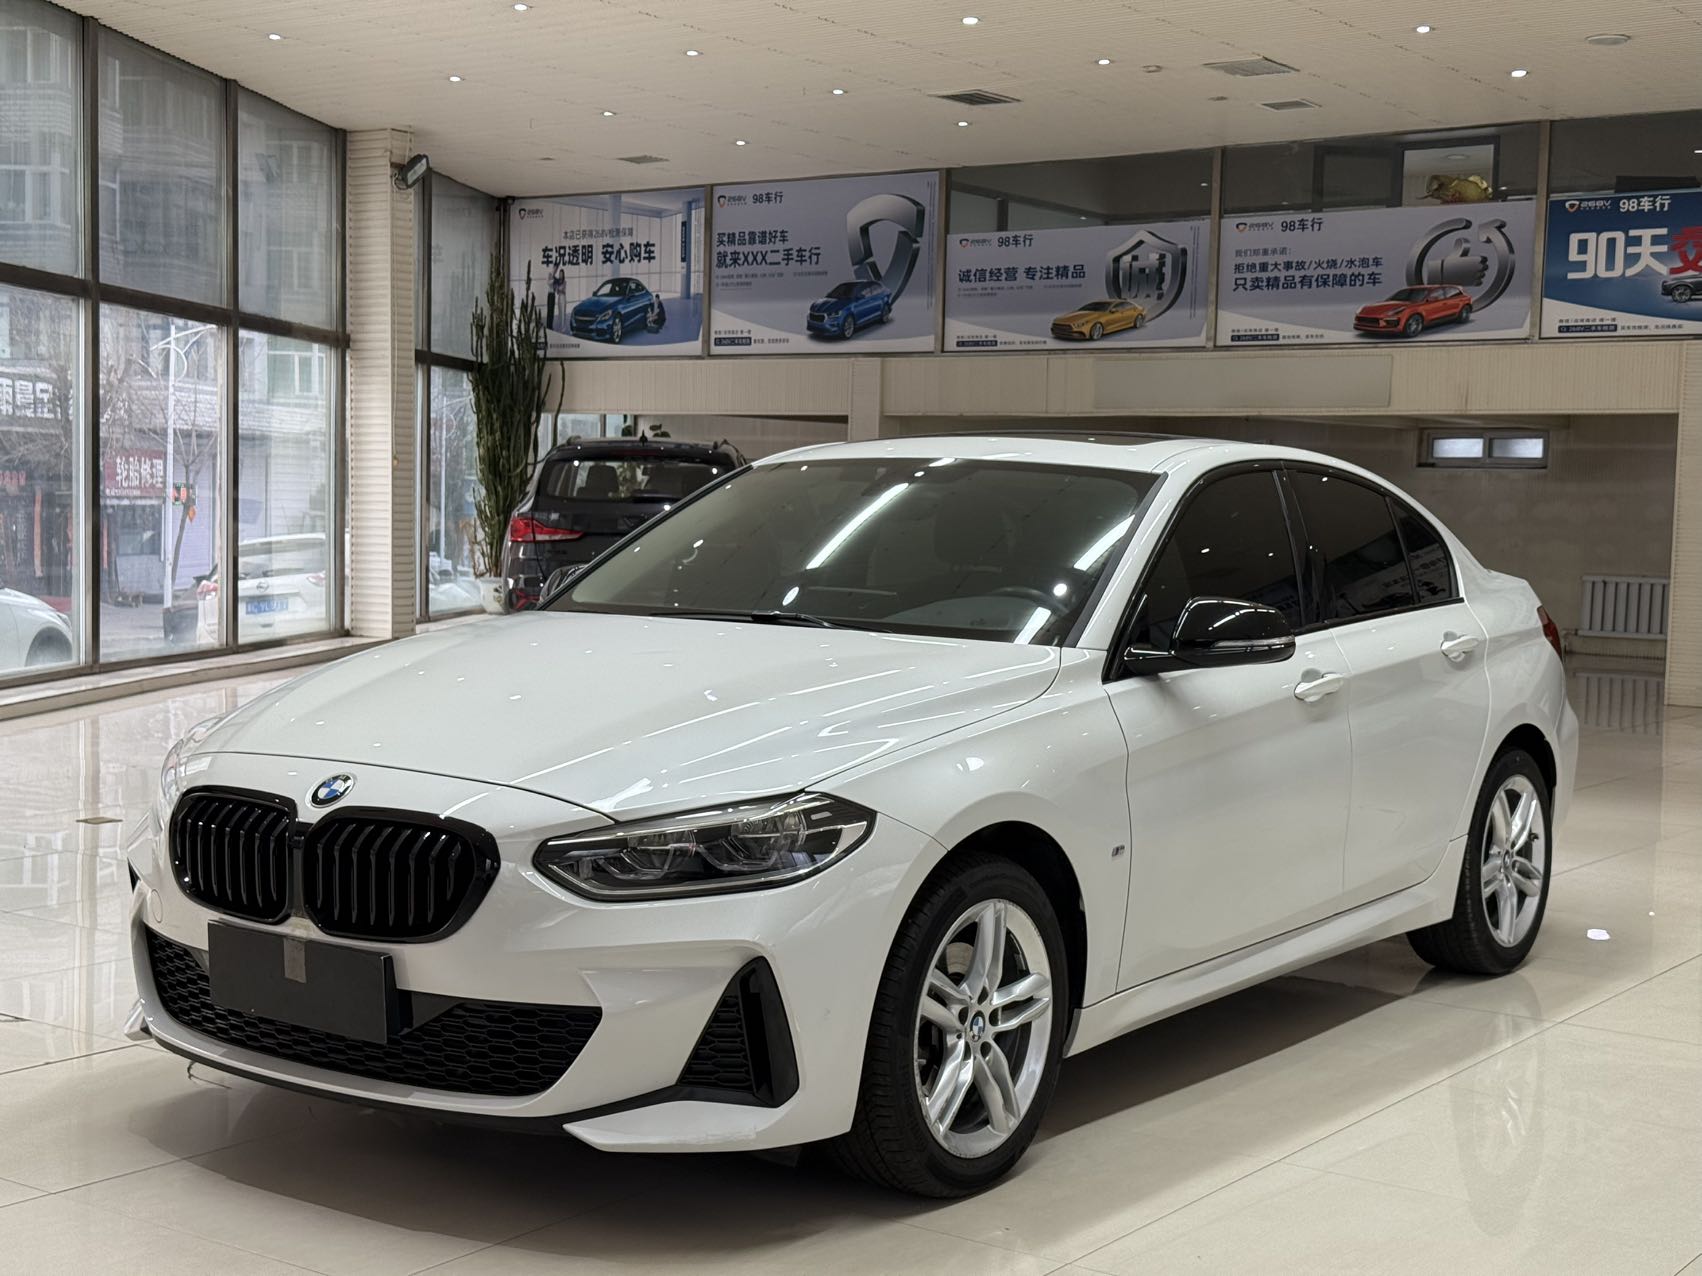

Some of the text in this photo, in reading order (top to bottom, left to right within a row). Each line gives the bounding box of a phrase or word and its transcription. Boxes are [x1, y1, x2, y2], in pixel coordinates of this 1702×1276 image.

[752, 191, 783, 204] 98车行
[1619, 195, 1671, 212] 98车行
[1280, 217, 1324, 233] 98车行
[716, 229, 789, 247] 买精品靠谱好车
[997, 234, 1033, 248] 98车行
[541, 241, 656, 267] 车况透明 安心购车
[716, 247, 822, 269] 就来XXX二手车行
[958, 264, 1086, 283] 诚信经营 专注精品
[1233, 256, 1383, 275] 拒绝重大事故/火烧/水泡车
[1233, 271, 1383, 292] 只卖精品有保障的车
[115, 456, 163, 488] 轮胎修理
